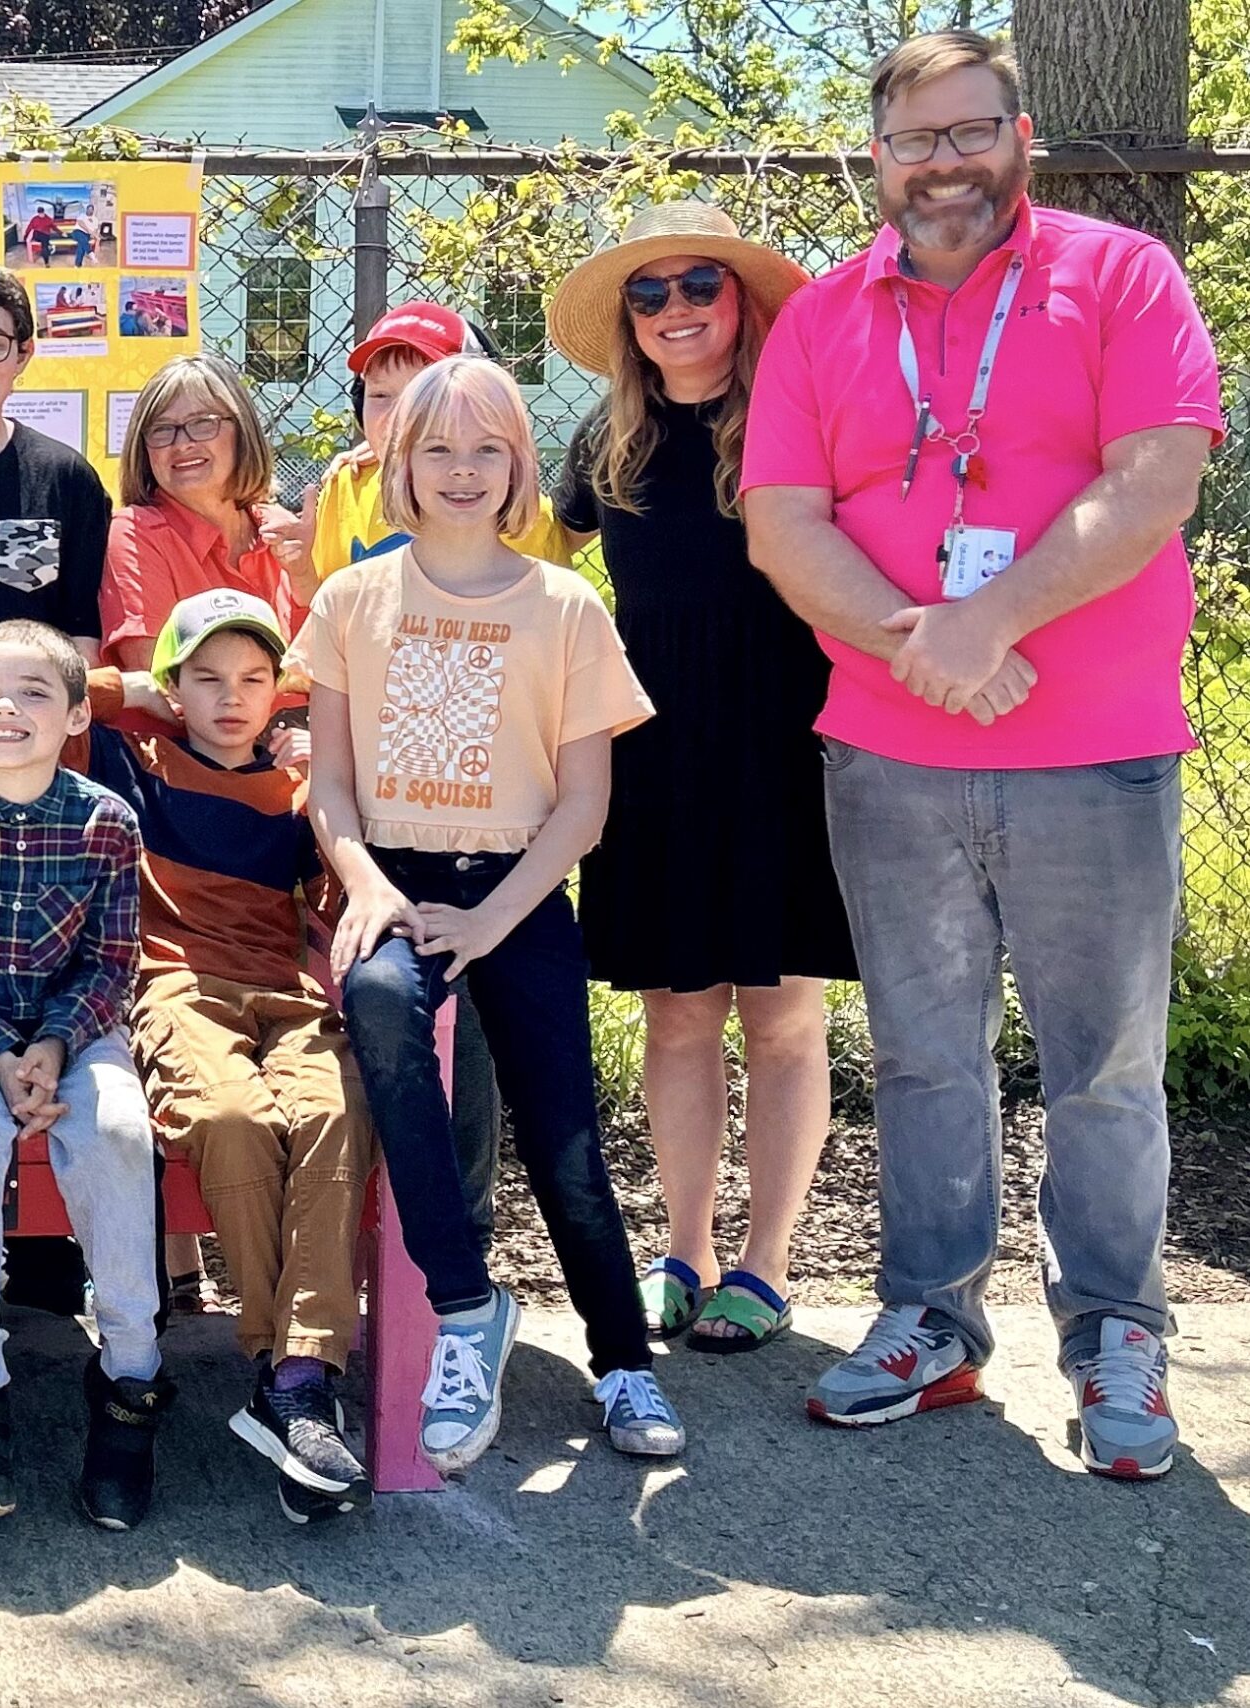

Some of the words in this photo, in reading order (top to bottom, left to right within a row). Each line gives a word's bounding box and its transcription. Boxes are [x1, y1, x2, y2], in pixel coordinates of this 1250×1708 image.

[398, 614, 429, 636] ALL
[434, 617, 465, 639] YOU
[467, 621, 511, 643] NEED
[375, 775, 397, 800] IS
[405, 779, 493, 810] SQUISH
